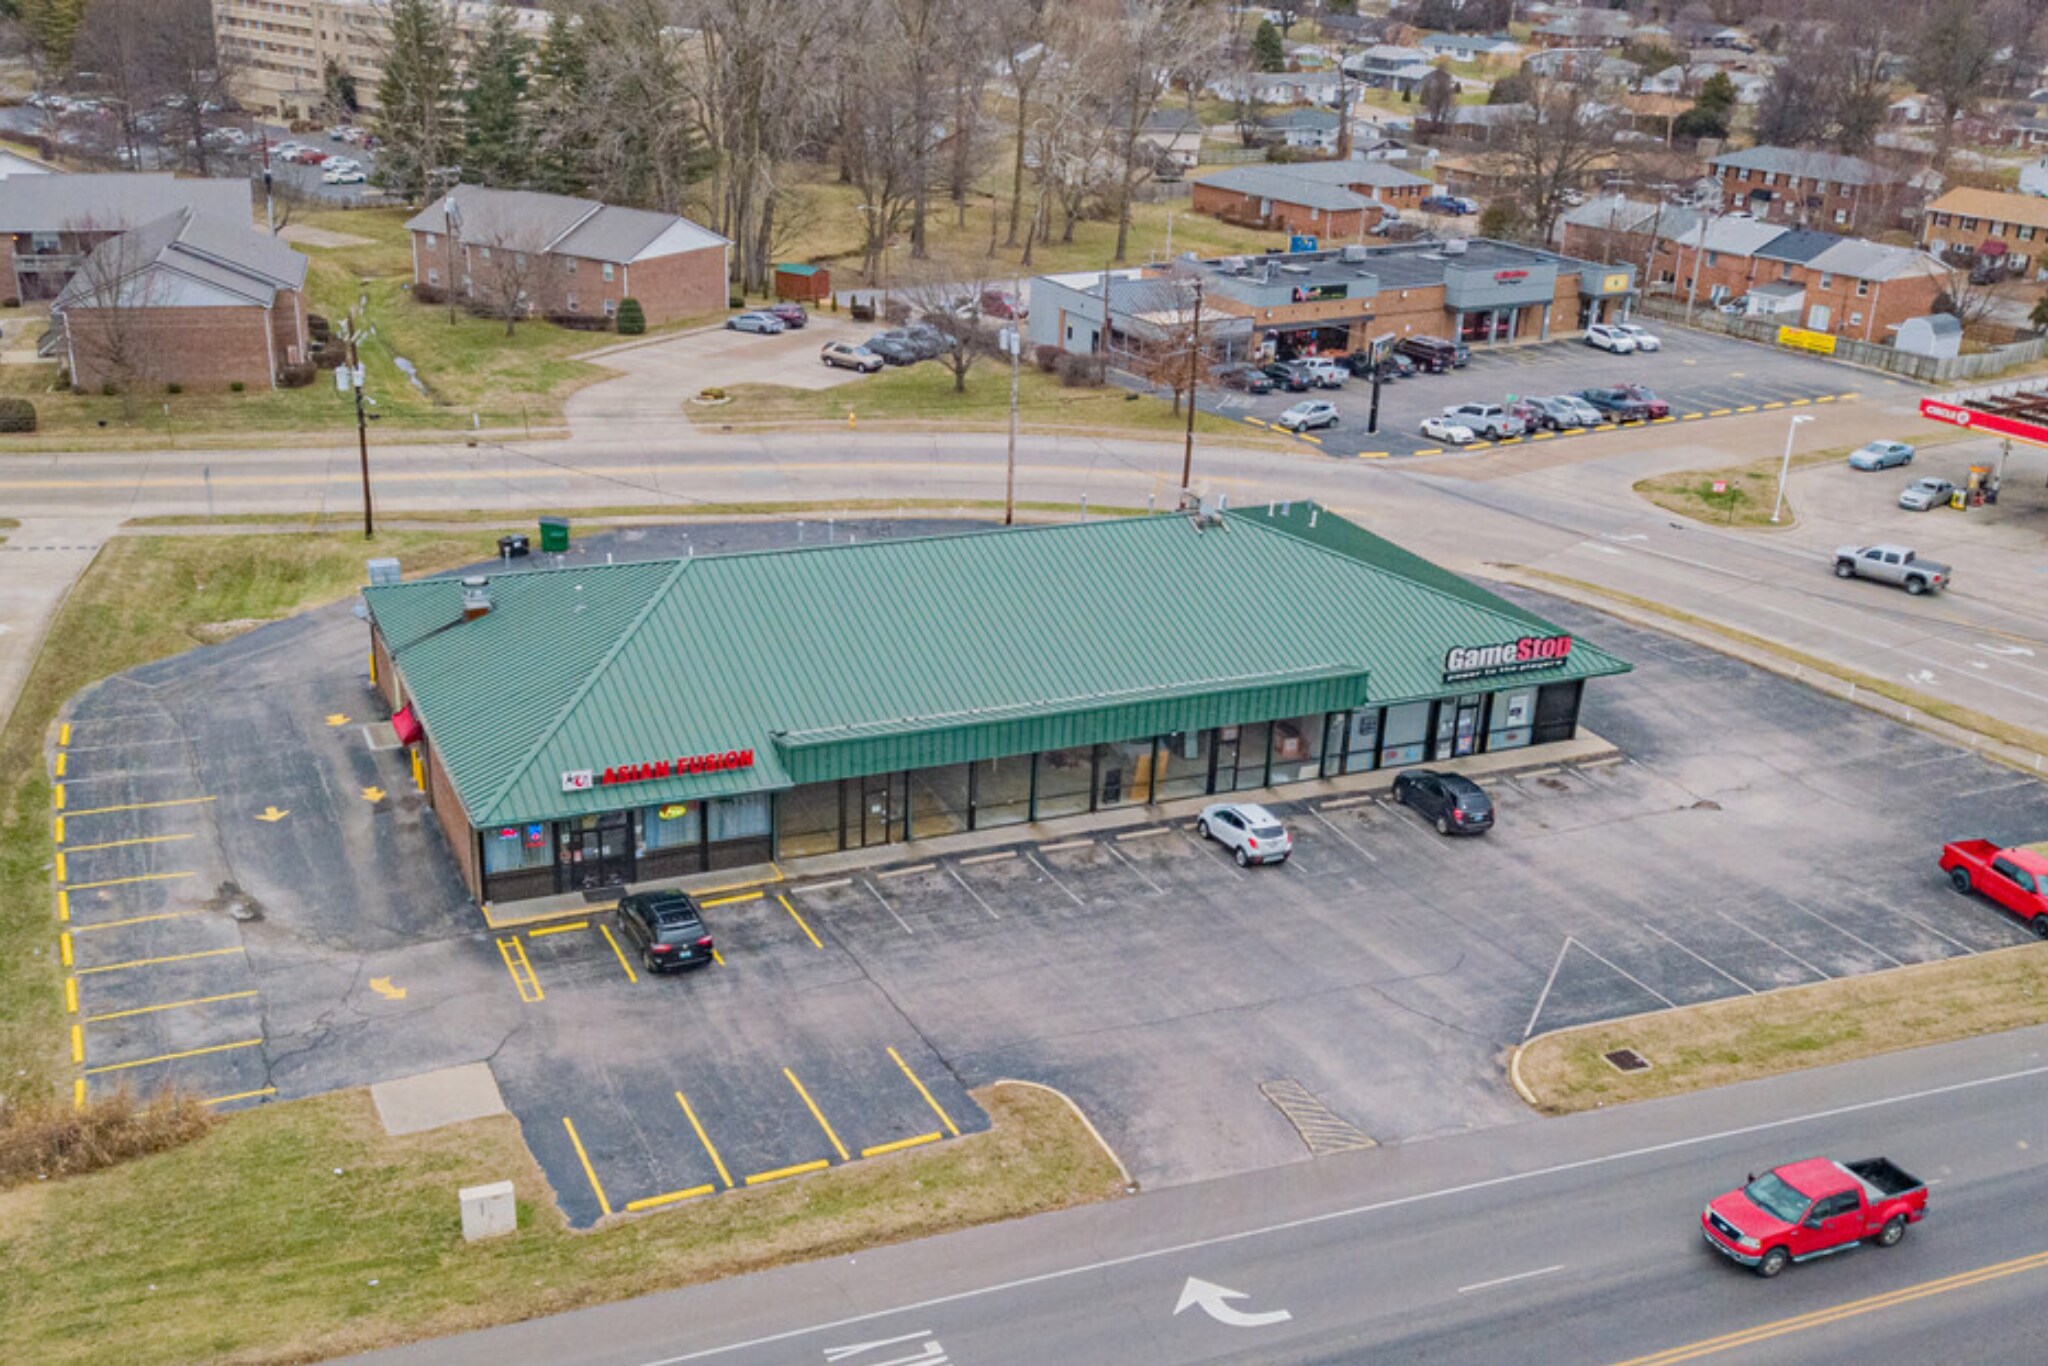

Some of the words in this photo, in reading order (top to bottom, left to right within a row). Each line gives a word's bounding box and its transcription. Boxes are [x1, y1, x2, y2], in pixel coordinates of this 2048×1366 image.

[1447, 636, 1572, 672] GameStop
[603, 761, 670, 785] ASIAN
[677, 749, 754, 775] FUSION
